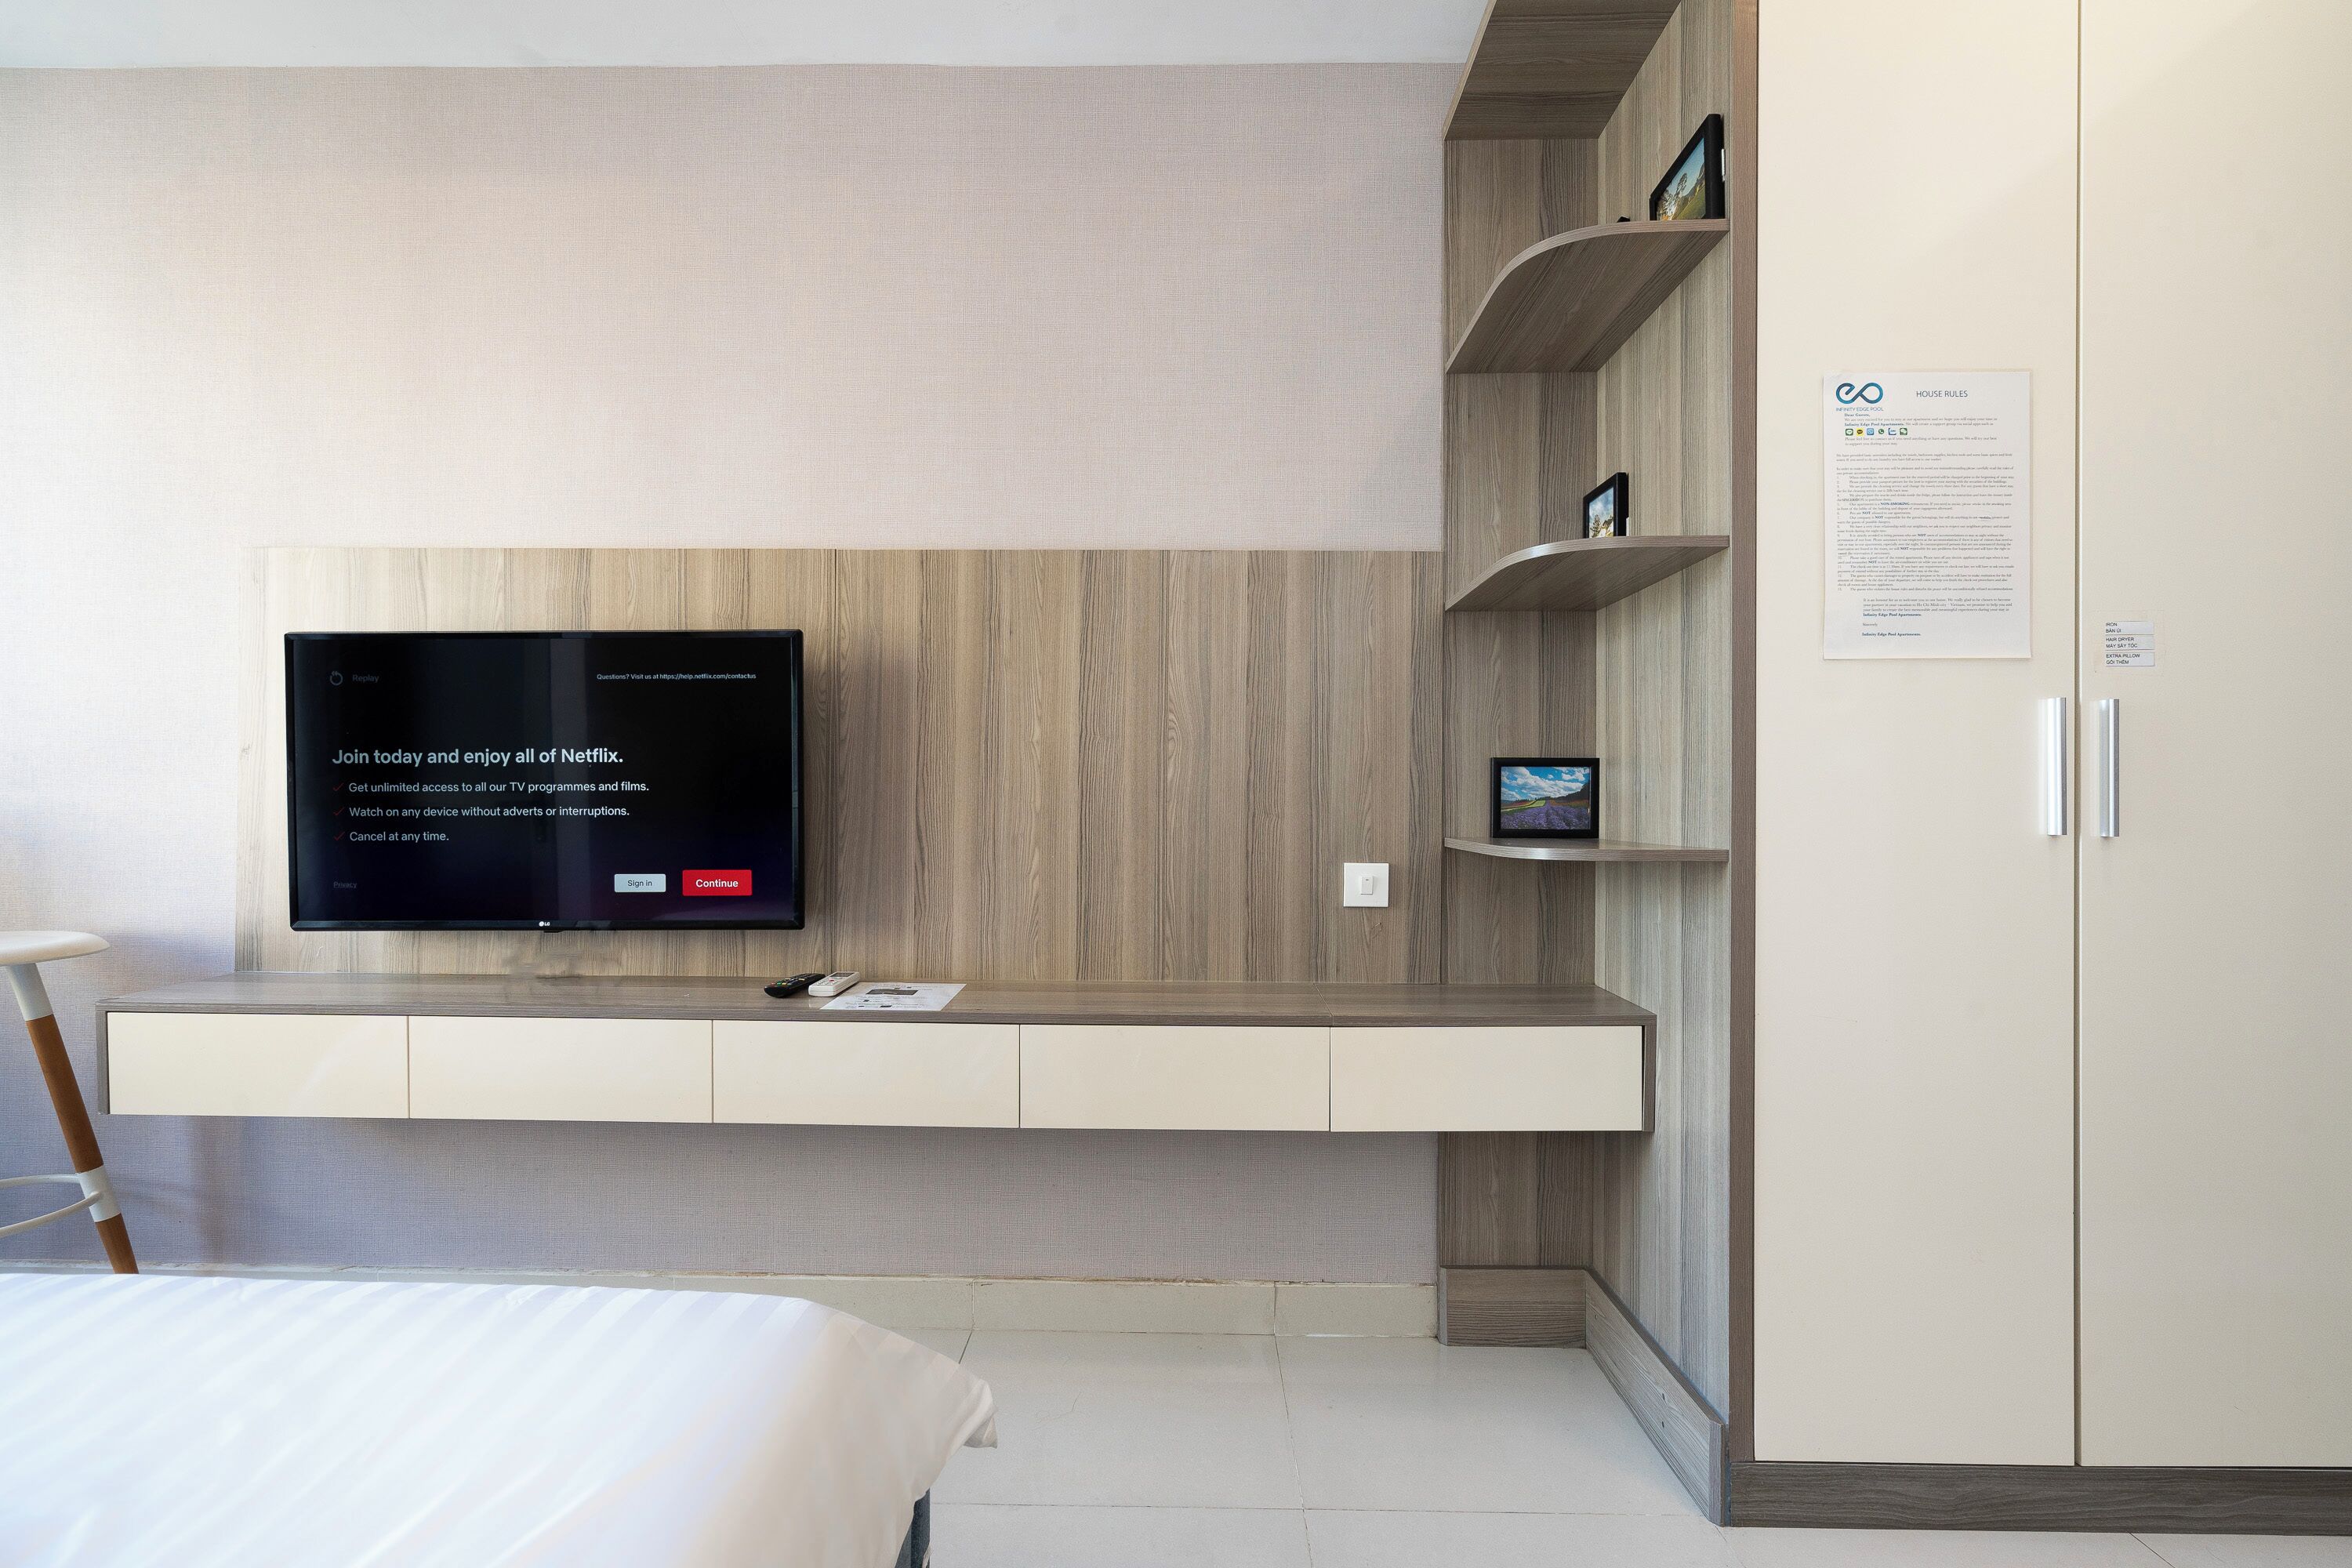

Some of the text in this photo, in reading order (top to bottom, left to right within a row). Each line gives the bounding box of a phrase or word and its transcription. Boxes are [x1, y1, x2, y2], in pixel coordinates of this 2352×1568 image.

[352, 673, 379, 684] Replay
[332, 747, 623, 768] Join today and enjoy all of Netflix.
[348, 782, 368, 793] Get
[371, 782, 419, 793] unlimited
[422, 784, 459, 793] access
[461, 782, 473, 792] to
[474, 781, 487, 792] all
[509, 782, 526, 792] TV
[528, 783, 597, 794] programmes
[597, 781, 619, 792] and
[620, 781, 650, 791] films.
[349, 805, 630, 819] Watch on any device without adverts or interruptions.
[349, 831, 449, 844] Cancel at any time.
[333, 880, 358, 889] Privacy
[627, 879, 644, 889] Sign
[695, 878, 739, 887] Continue
